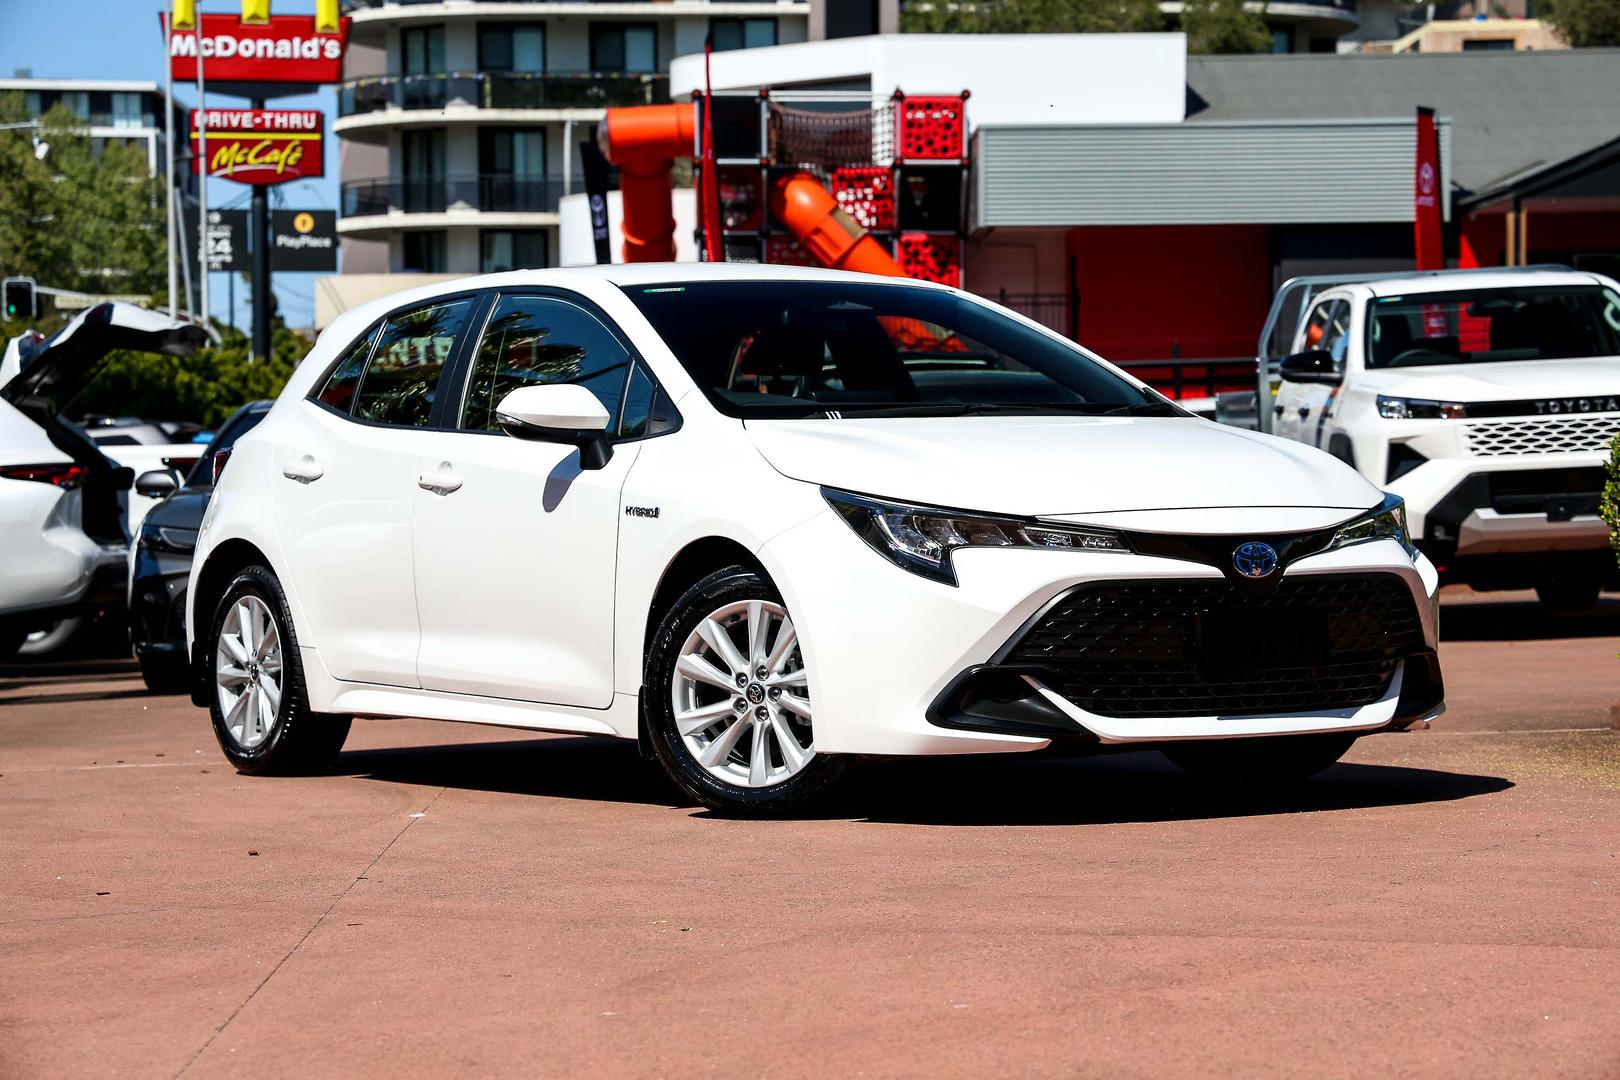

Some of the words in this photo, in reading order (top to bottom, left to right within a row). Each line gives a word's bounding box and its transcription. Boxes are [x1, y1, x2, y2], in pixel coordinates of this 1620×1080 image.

[171, 34, 341, 59] McDonald's
[211, 139, 303, 176] McCafé
[276, 234, 332, 250] PlayPlace
[1535, 398, 1619, 414] TOYOTA
[625, 505, 660, 519] HYBRID
